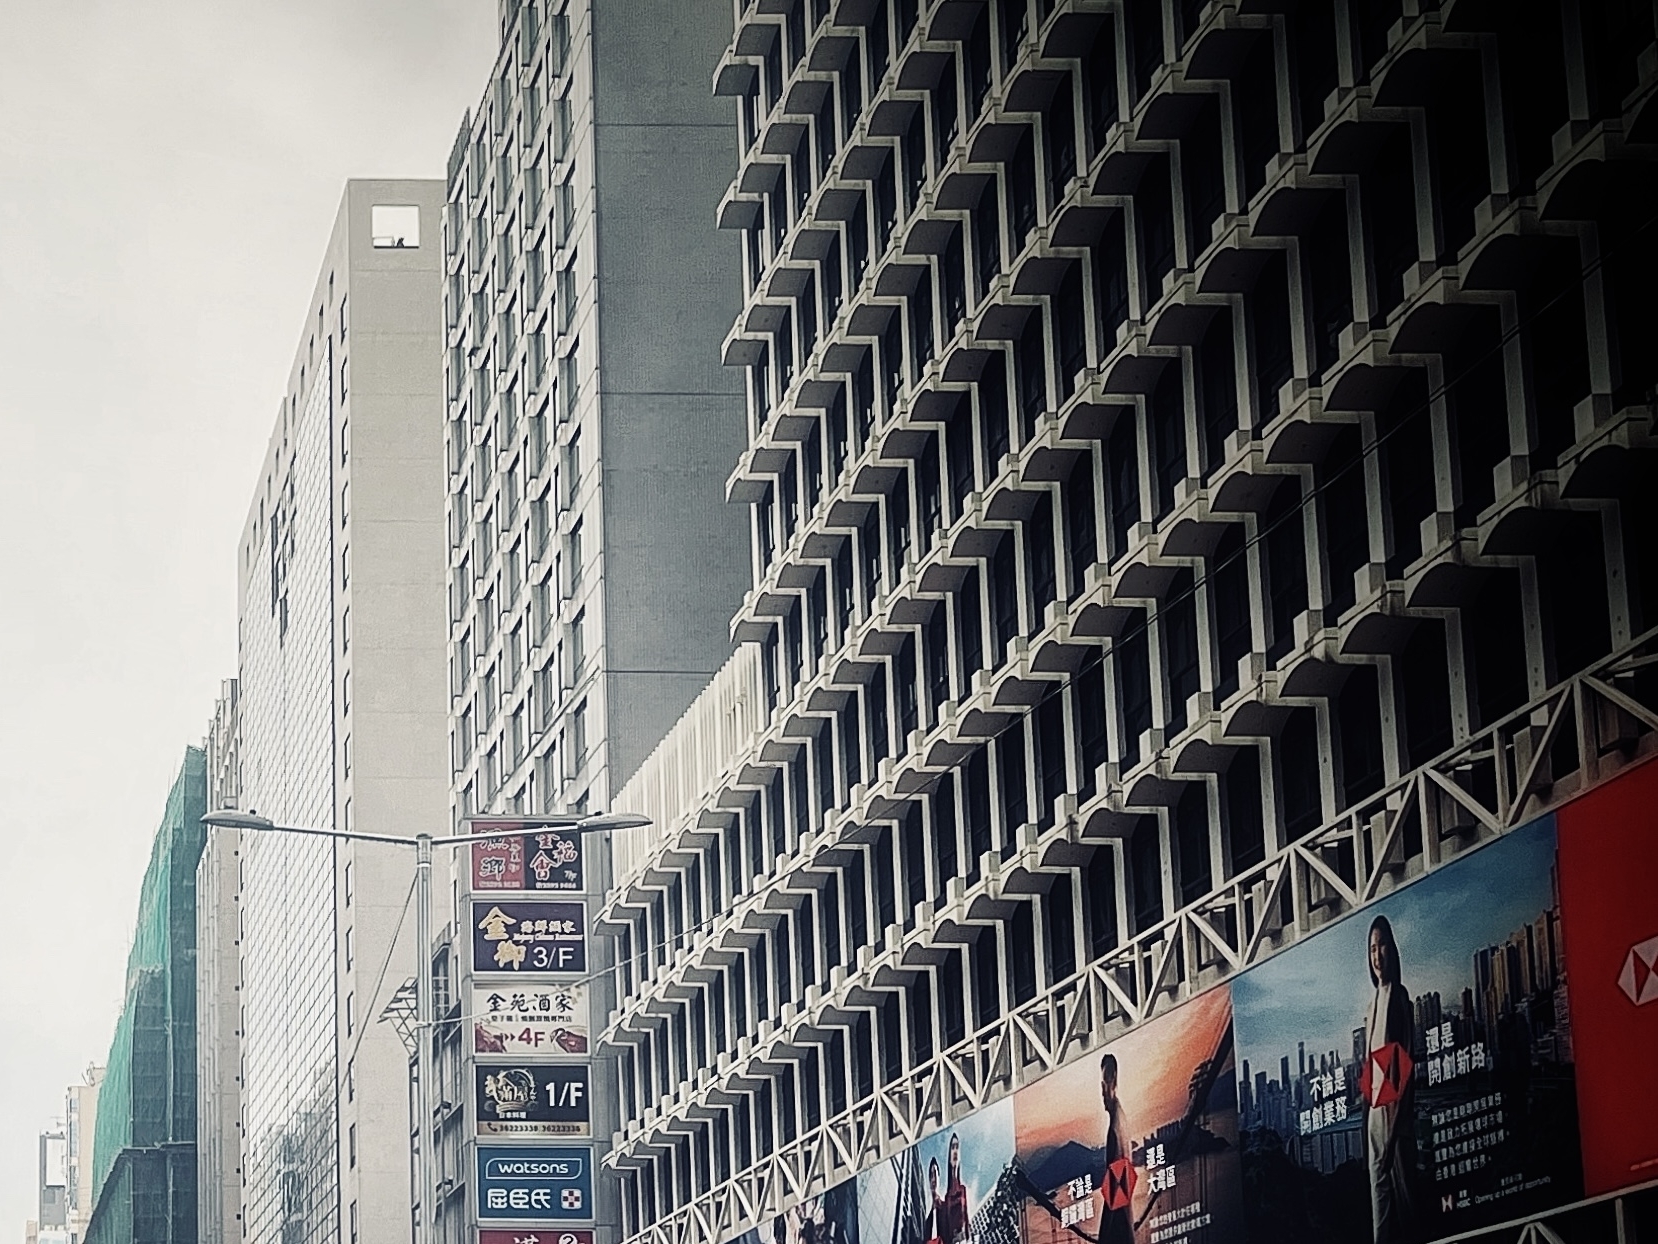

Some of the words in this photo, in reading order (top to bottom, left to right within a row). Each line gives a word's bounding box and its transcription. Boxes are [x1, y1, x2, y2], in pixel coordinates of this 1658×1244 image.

[533, 947, 575, 969] 3/F
[518, 1028, 546, 1048] 4F
[1425, 1021, 1455, 1055] 還是
[1427, 1042, 1486, 1087] 開創新路
[545, 1082, 584, 1107] 1/F
[1310, 1066, 1346, 1102] 不論是
[498, 1163, 569, 1174] watsons
[487, 1188, 551, 1209] 屈臣氏
